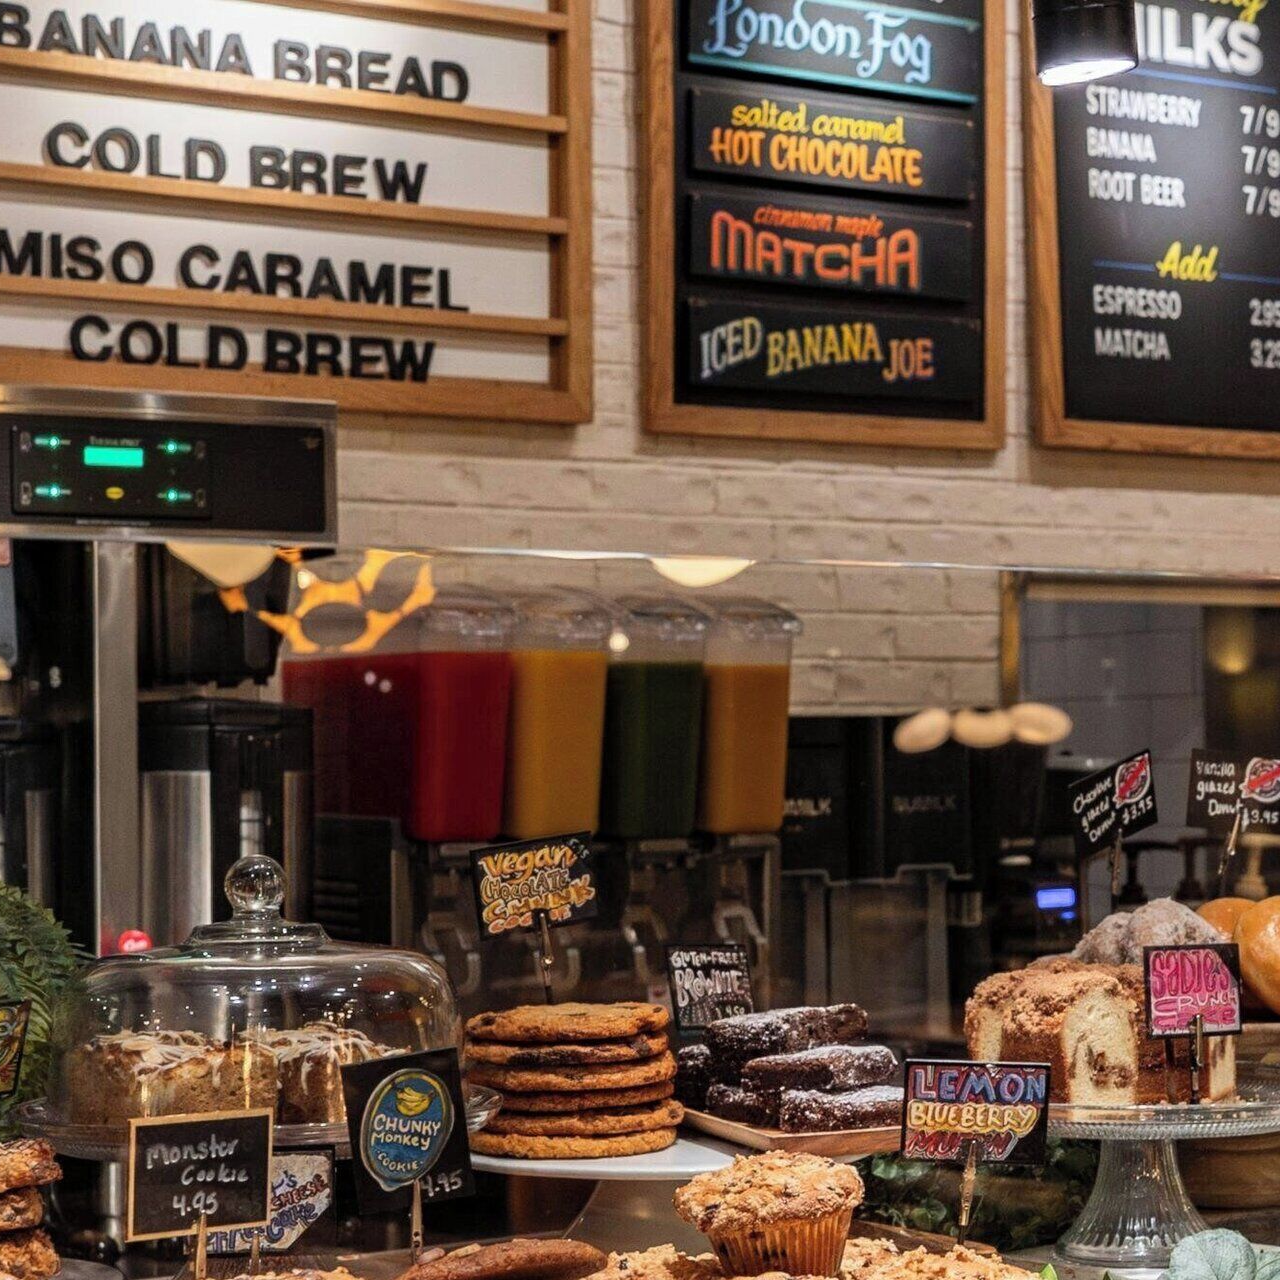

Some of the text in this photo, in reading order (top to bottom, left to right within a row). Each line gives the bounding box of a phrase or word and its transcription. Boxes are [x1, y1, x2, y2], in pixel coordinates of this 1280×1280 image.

[703, 0, 932, 84] London Fog
[273, 38, 471, 103] BREAD
[731, 100, 905, 145] salted caramel
[1085, 84, 1280, 138] STRAWBERRY 7/9
[44, 122, 428, 204] COLD BREW
[710, 127, 924, 187] HOT CHOCOLATE
[1086, 126, 1157, 164] BANANA
[1088, 168, 1136, 202] ROOT
[1140, 174, 1186, 208] BEER
[710, 209, 919, 289] MATCHA
[1156, 241, 1218, 282] Add
[178, 244, 470, 312] CARAMEL
[1092, 284, 1182, 321] ESPRESSO
[68, 314, 437, 383] COLD BREW
[700, 316, 935, 382] ICED BANANA JOE
[1095, 327, 1171, 362] MATCHA
[478, 845, 577, 883] Vegan
[481, 868, 570, 905] CHOCOLATE
[675, 967, 744, 1007] BROWNIE
[915, 1069, 1046, 1103] LEMON
[373, 1114, 440, 1136] CHUNKY
[909, 1102, 1036, 1128] BLUEBERRY
[146, 1133, 240, 1170] Monster
[371, 1131, 430, 1150] Monkey
[181, 1162, 249, 1186] Cookie
[421, 1169, 462, 1196] 4.95
[172, 1191, 219, 1216] 4.95
